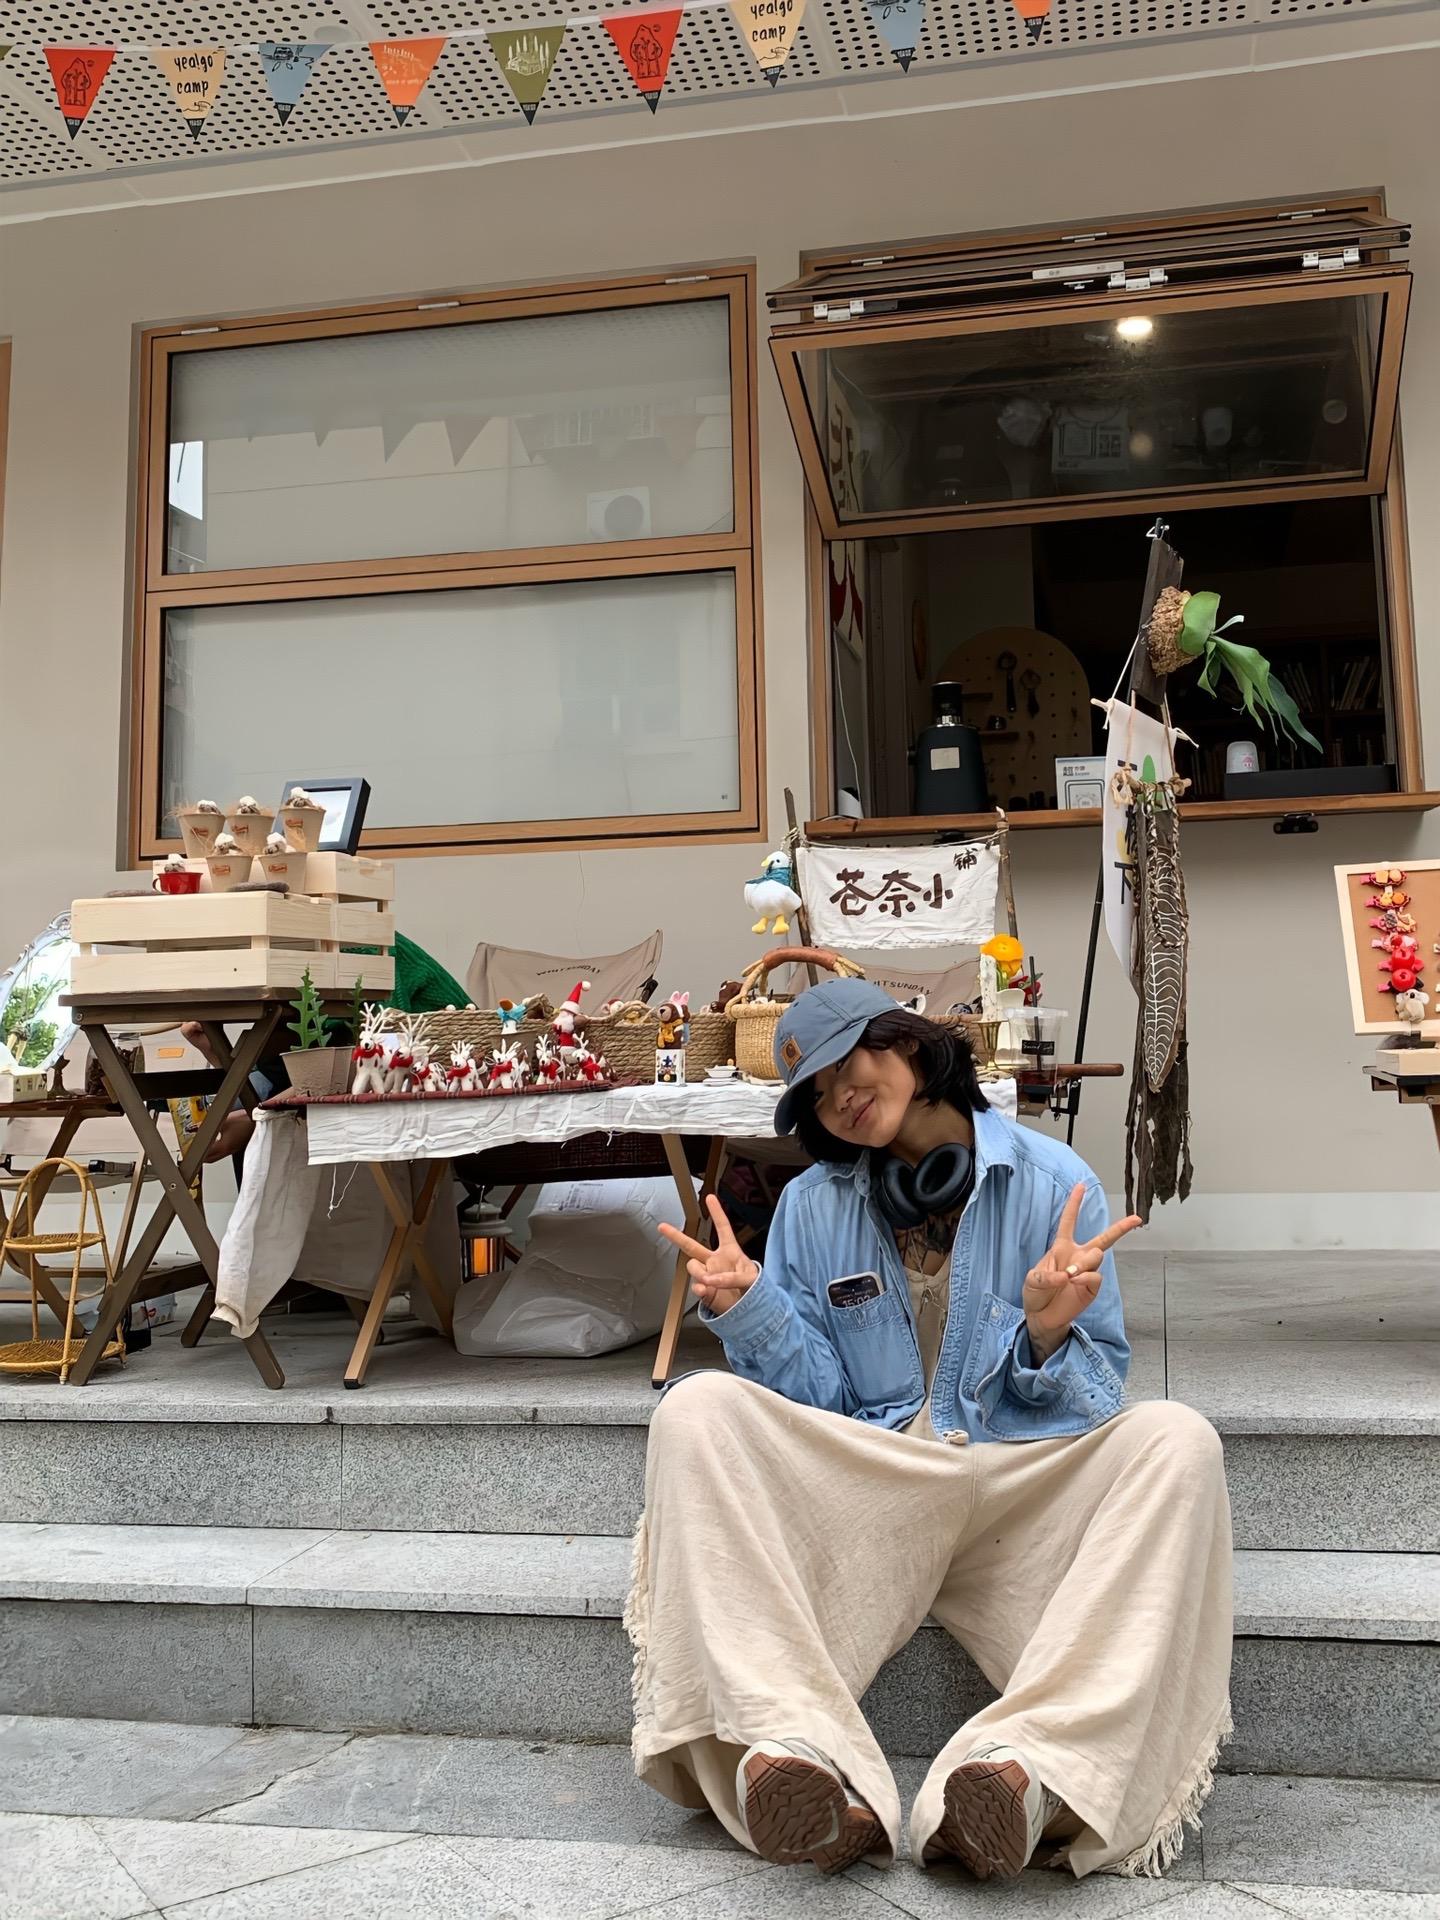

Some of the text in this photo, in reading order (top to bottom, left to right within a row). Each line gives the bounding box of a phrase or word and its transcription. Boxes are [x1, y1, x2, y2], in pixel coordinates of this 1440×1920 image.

[752, 25, 787, 42] camp
[177, 80, 209, 97] camp
[873, 980, 934, 996] ITSUNDAY
